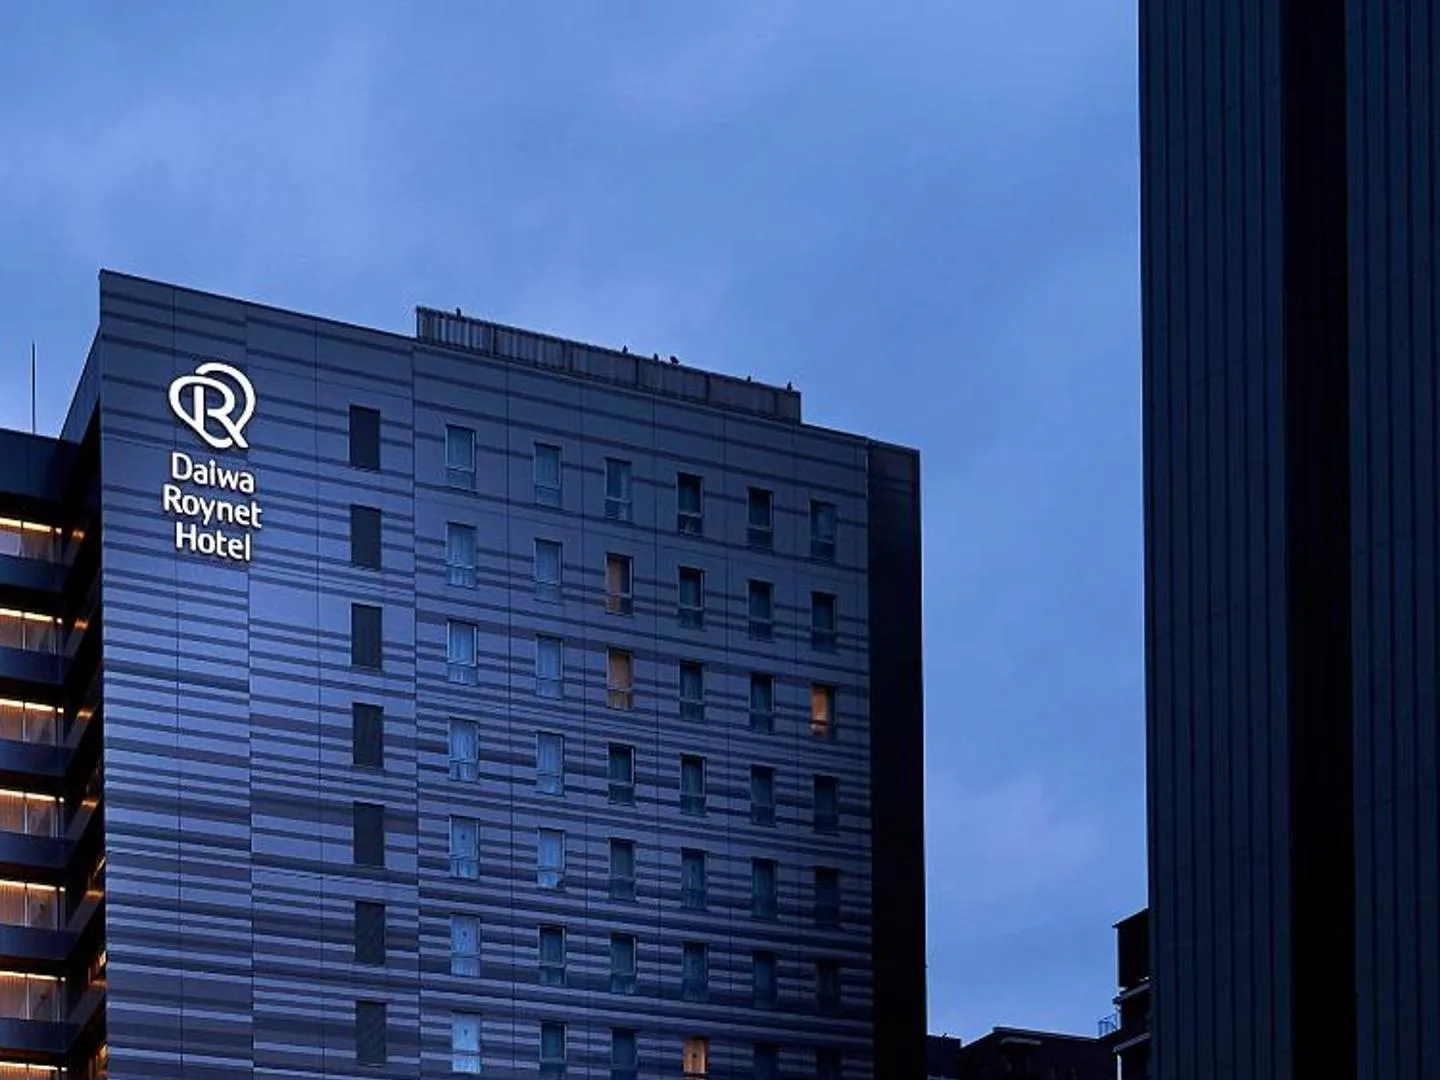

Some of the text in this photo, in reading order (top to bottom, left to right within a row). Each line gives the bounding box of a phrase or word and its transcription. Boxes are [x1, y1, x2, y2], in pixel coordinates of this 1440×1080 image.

[171, 452, 255, 494] Daiwa
[163, 484, 262, 529] Roynet
[175, 523, 251, 562] Hotel
